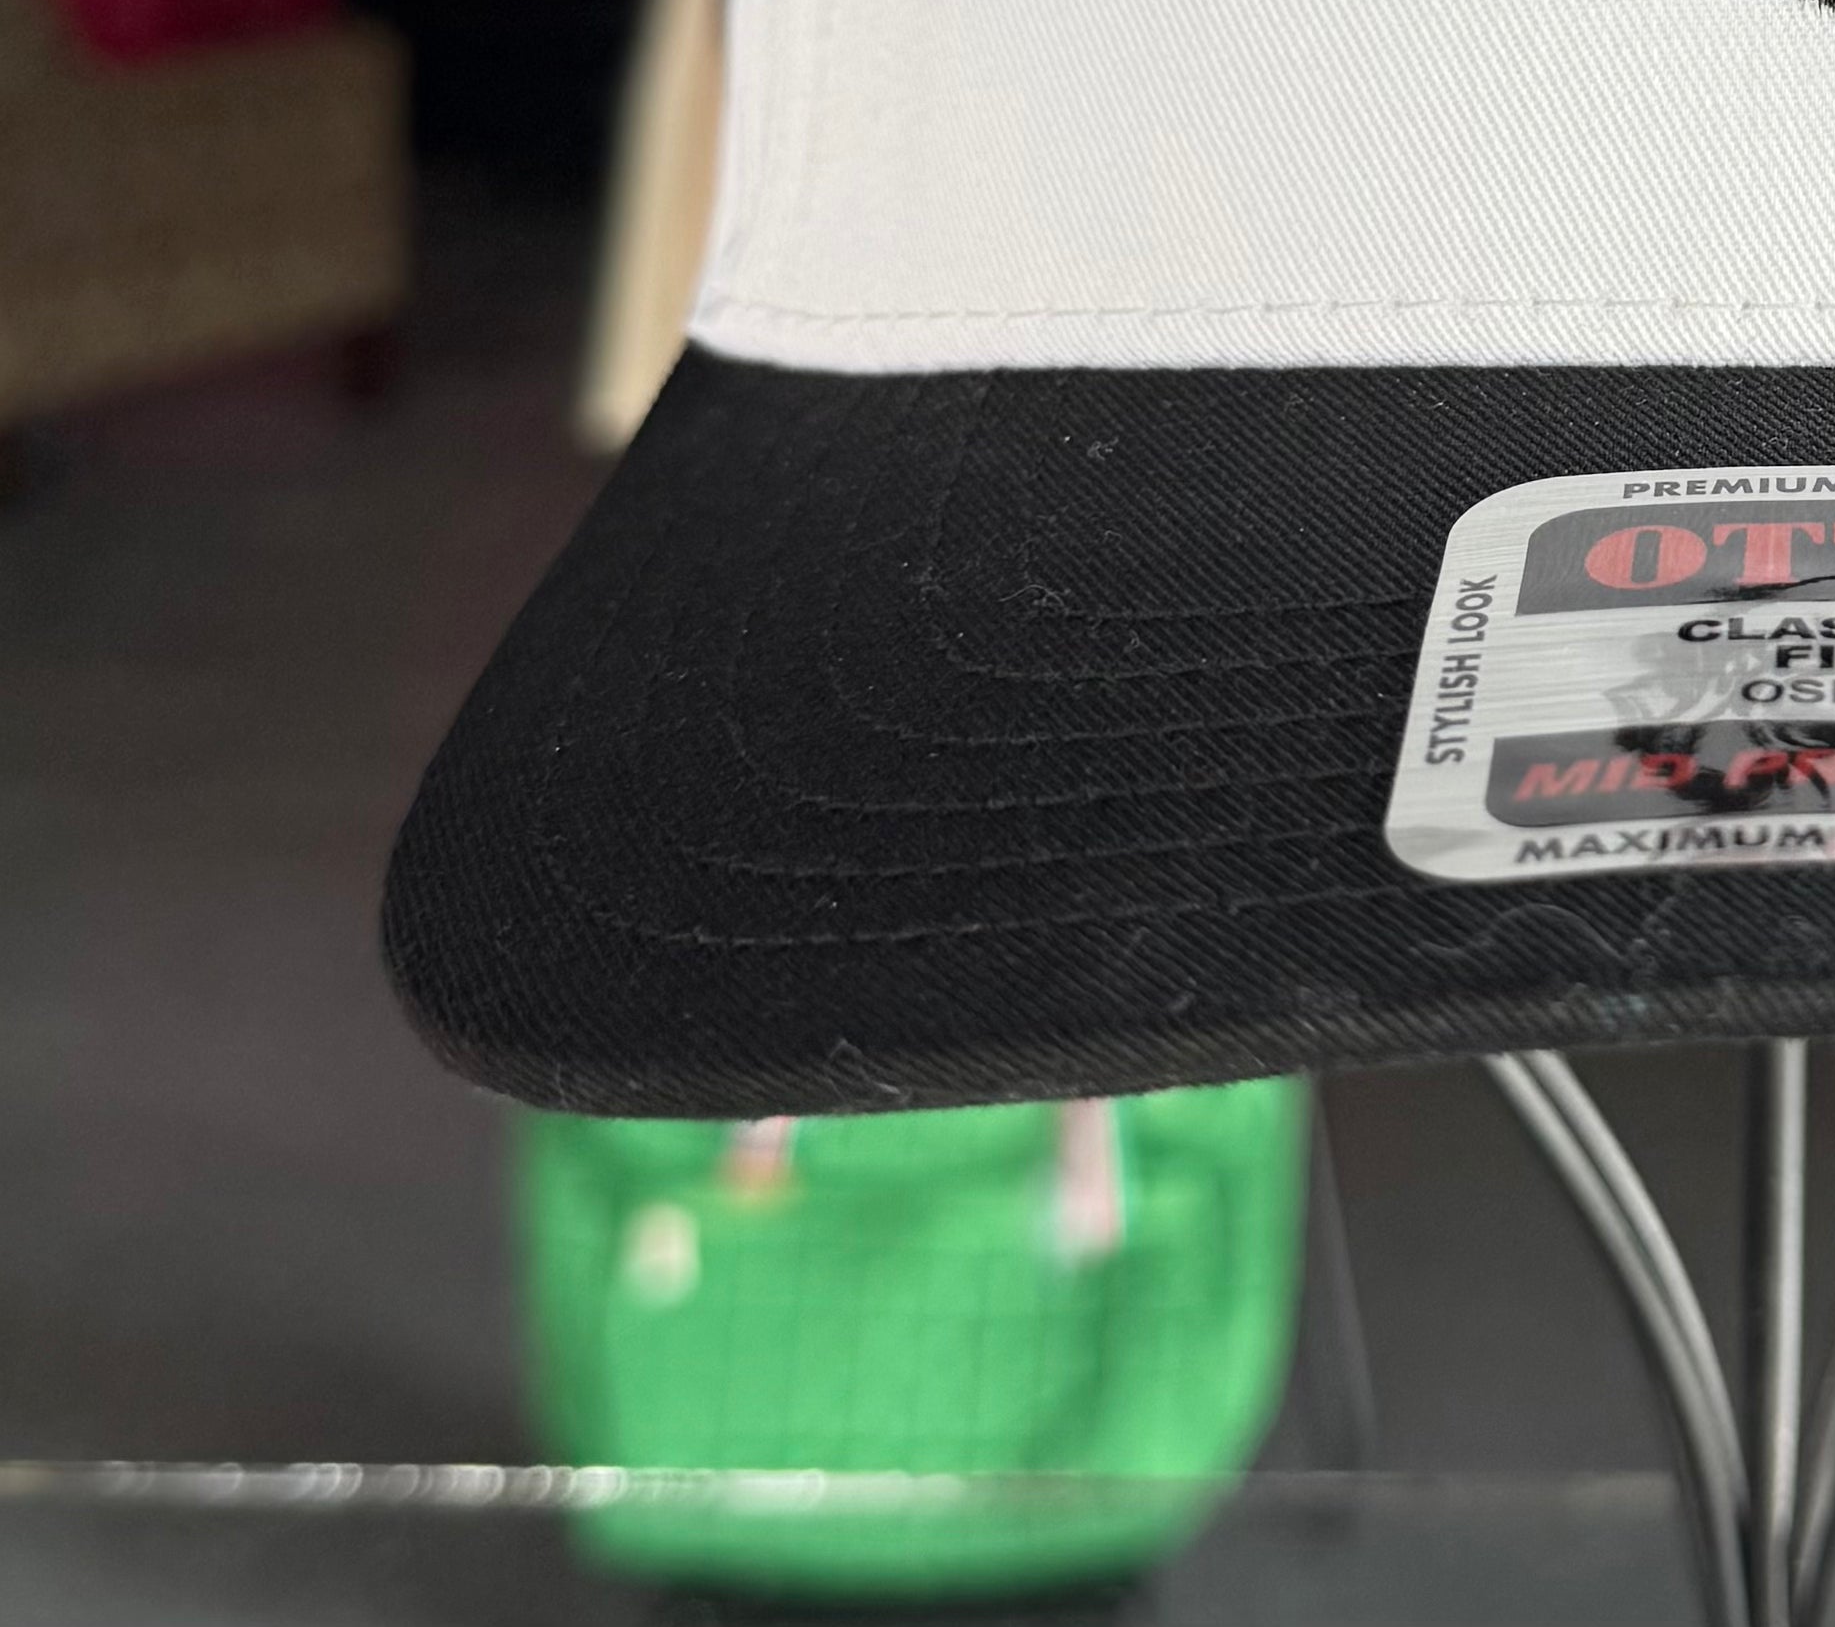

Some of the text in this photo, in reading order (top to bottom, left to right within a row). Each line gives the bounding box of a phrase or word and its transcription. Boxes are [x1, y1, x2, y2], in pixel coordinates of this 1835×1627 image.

[1425, 574, 1498, 766] STYLISH LOOK
[1512, 752, 1700, 802] MID
[1514, 820, 1827, 864] MAXIMUM
